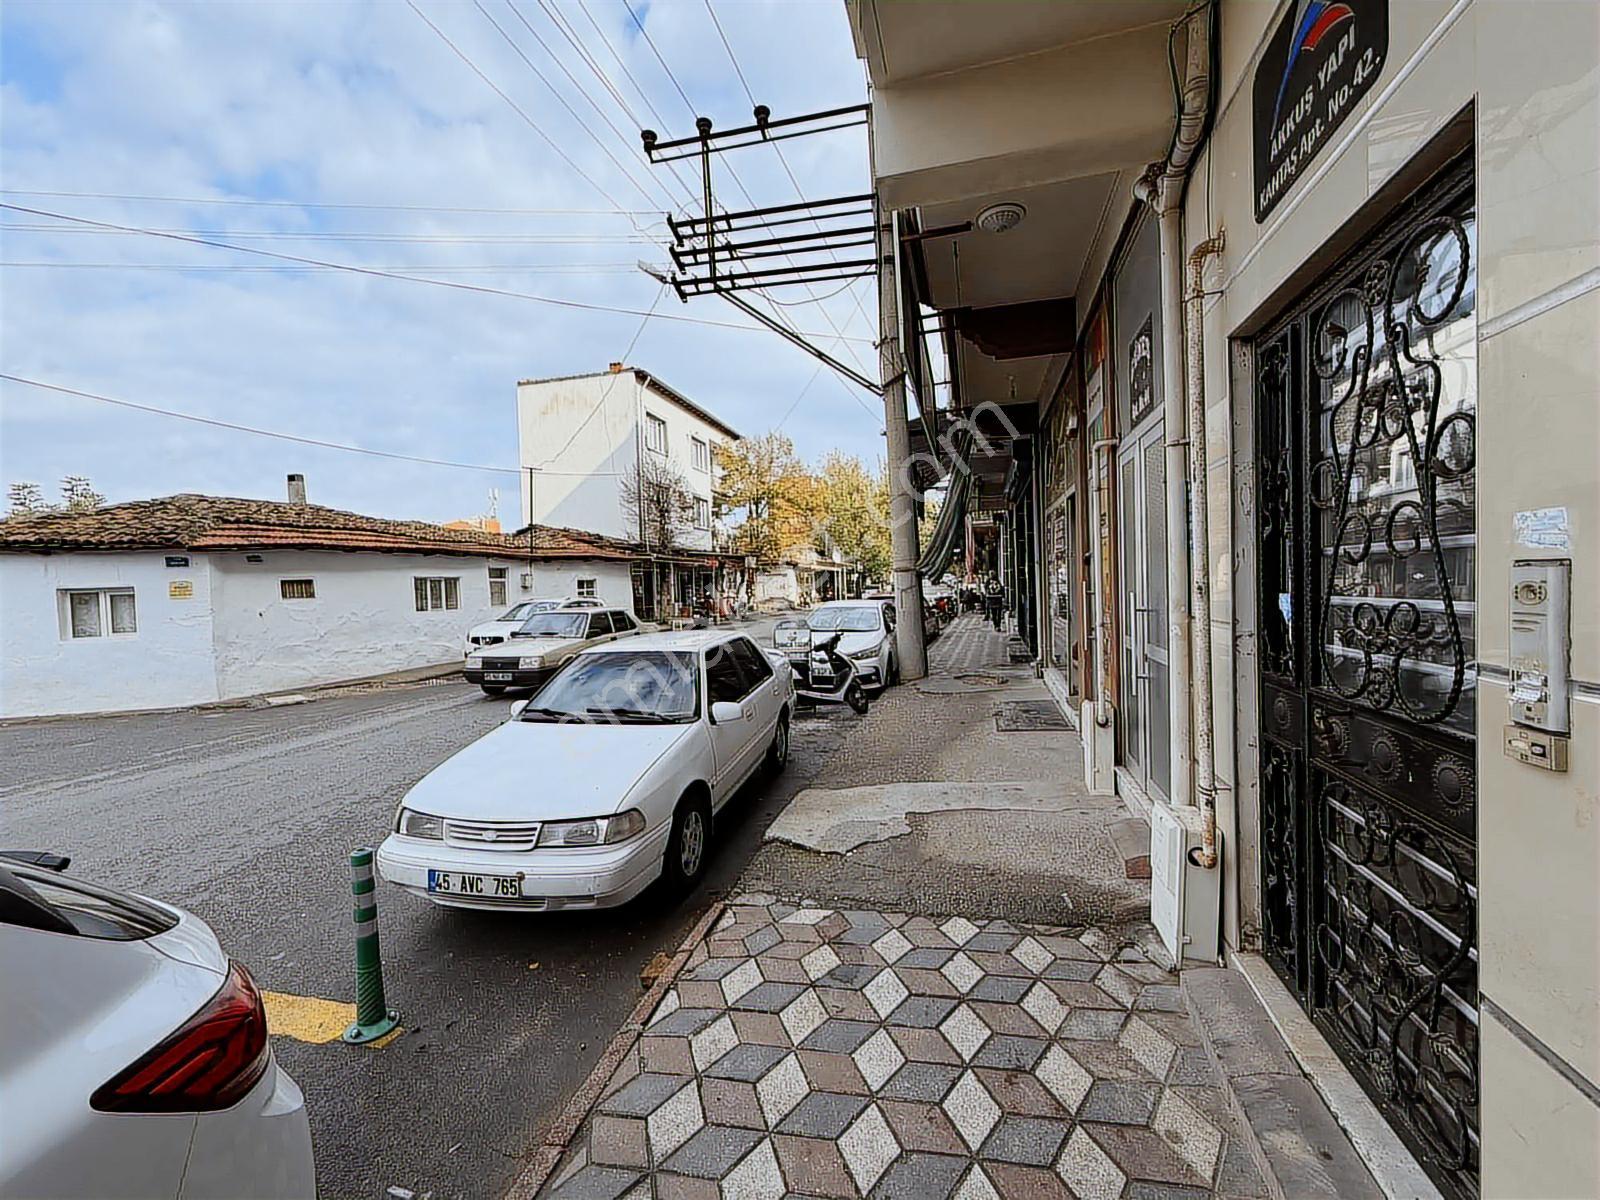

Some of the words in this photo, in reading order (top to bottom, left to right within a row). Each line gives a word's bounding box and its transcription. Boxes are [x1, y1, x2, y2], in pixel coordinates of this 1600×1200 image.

[1270, 84, 1314, 163] AKKUŞ
[1316, 23, 1356, 91] YAPI
[435, 873, 451, 891] 45
[460, 875, 484, 894] AVC
[493, 877, 518, 896] 765
